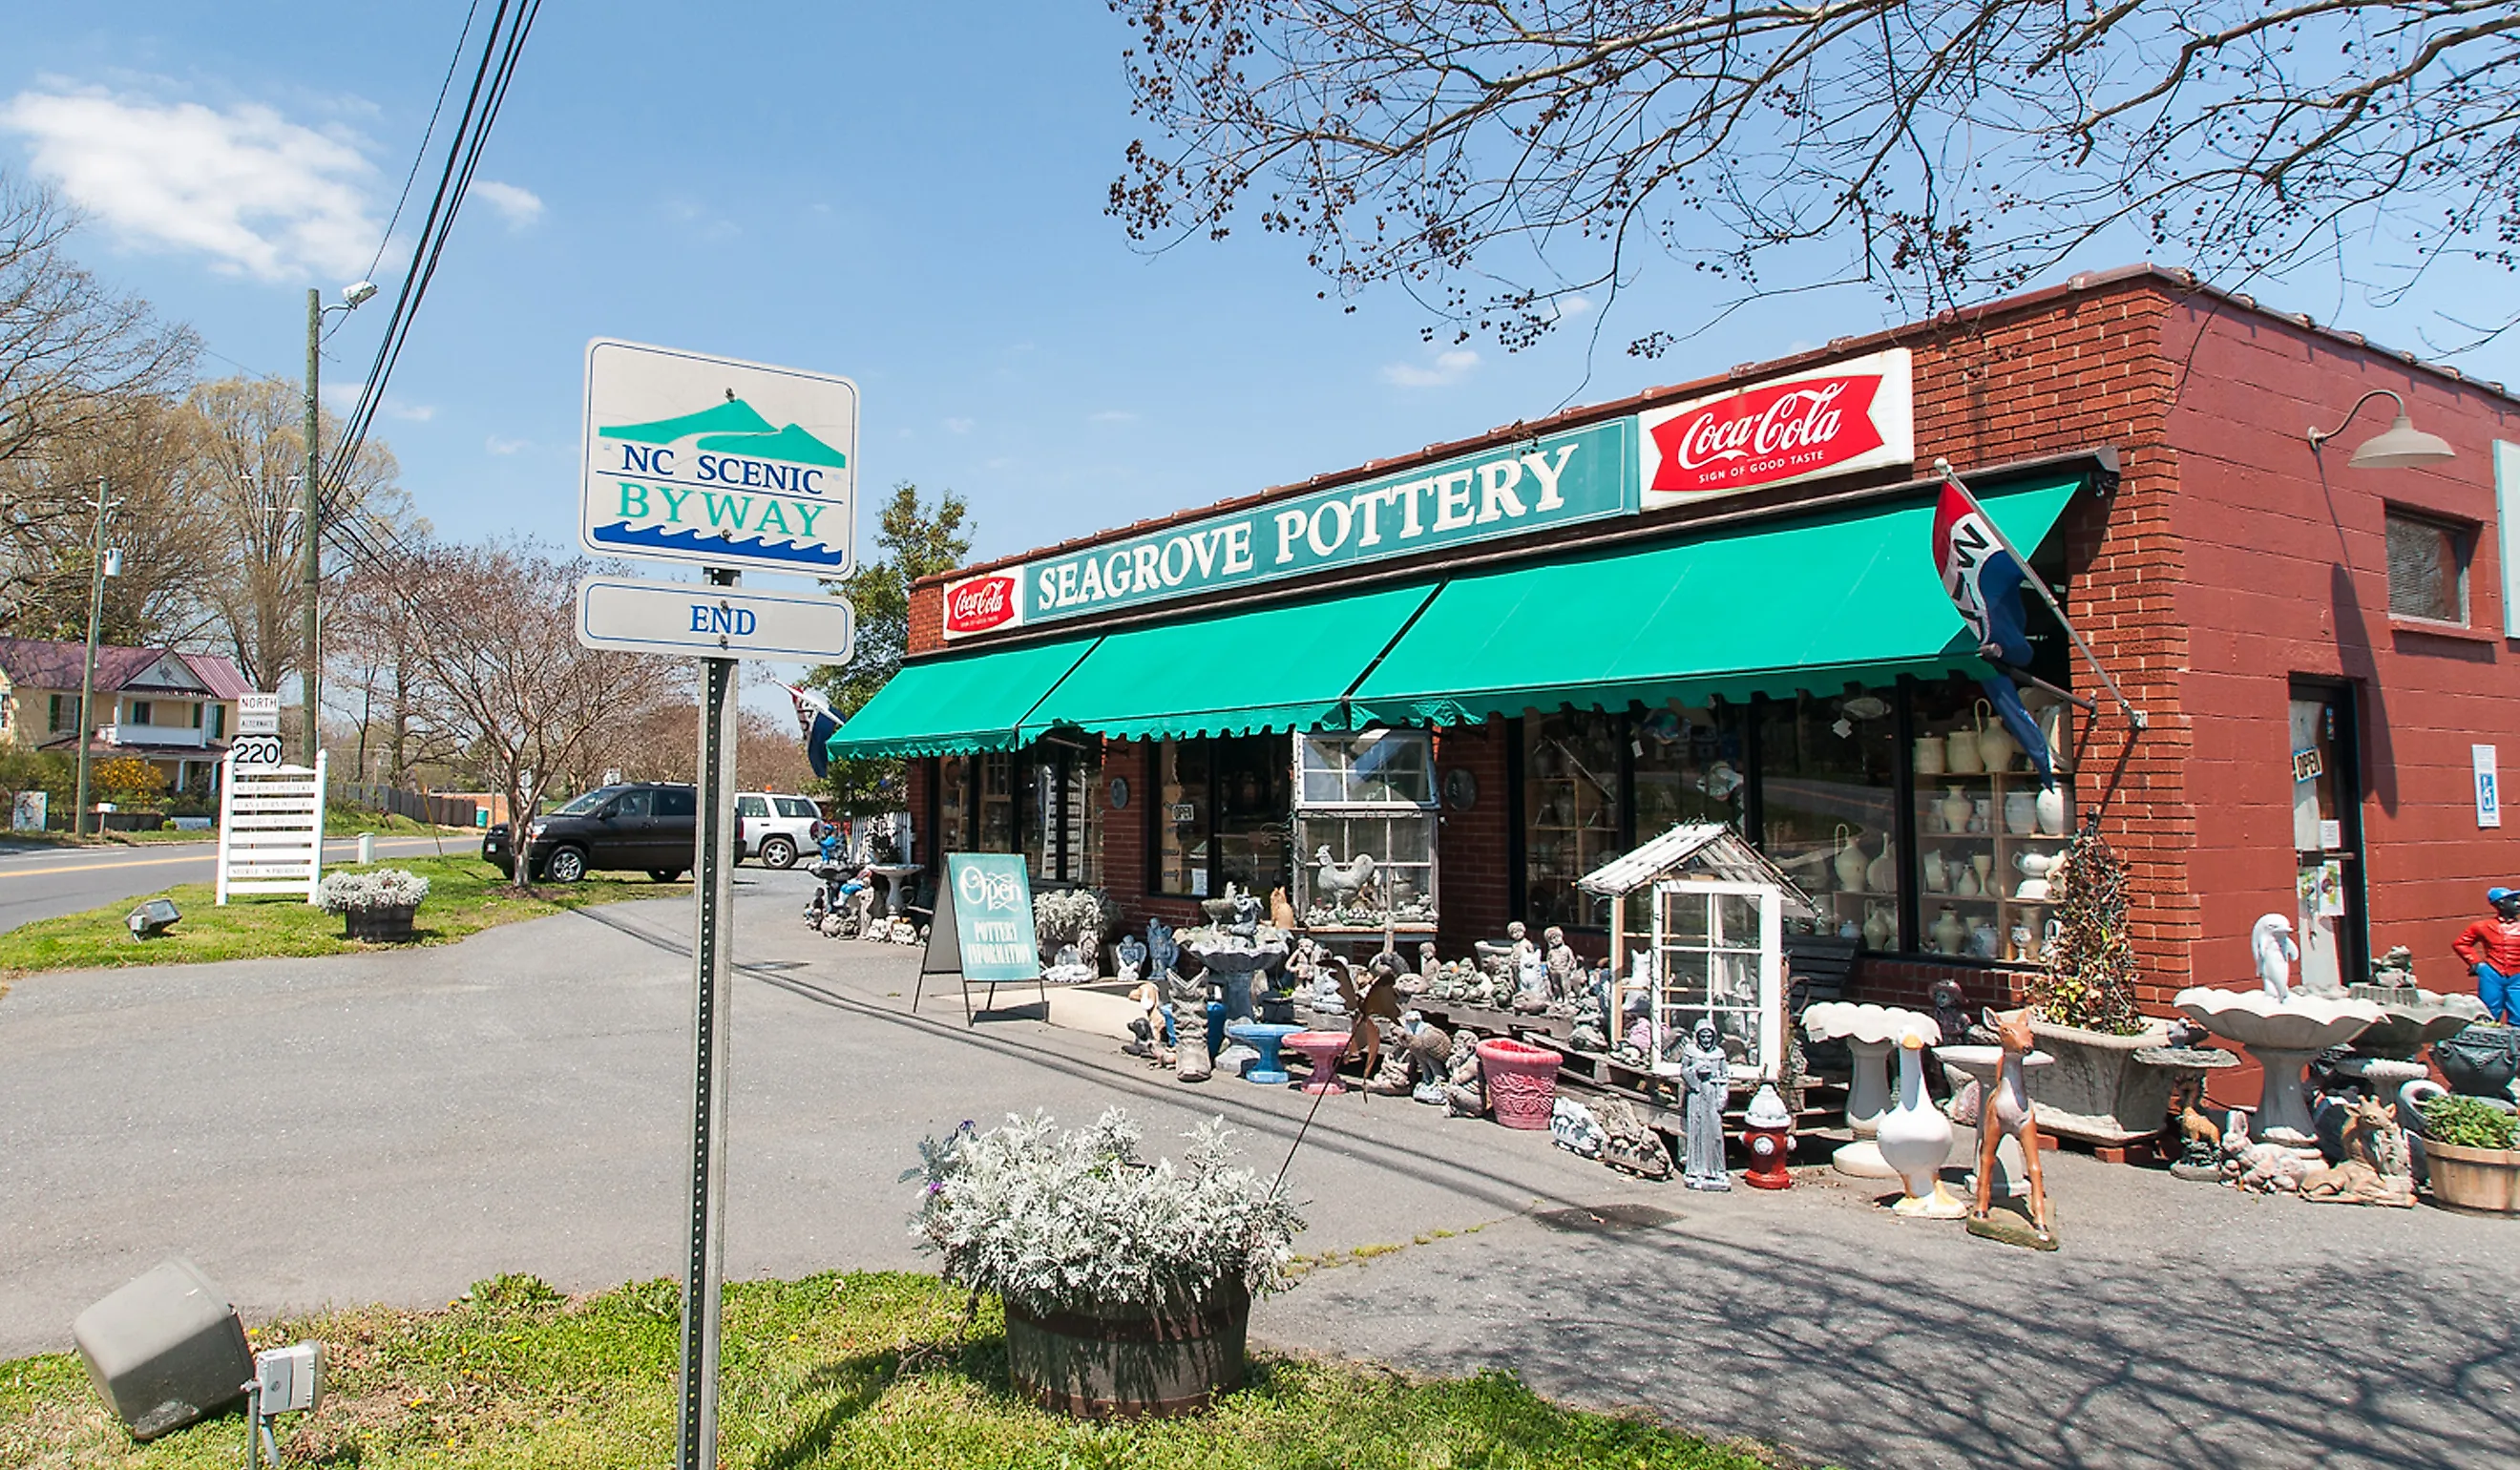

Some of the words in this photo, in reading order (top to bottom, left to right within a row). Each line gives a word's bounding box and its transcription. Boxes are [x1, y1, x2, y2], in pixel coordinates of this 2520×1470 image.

[1678, 381, 1849, 470] Coca-Cola
[621, 444, 675, 474] NC
[697, 454, 824, 494] SCENIC
[1698, 470, 1726, 484] SIGN
[1730, 466, 1746, 477] OF
[1750, 458, 1785, 473] GOOD
[1790, 451, 1825, 465] TASTE
[616, 481, 828, 538] BYWAY
[1038, 521, 1254, 611] SEAGROVE
[1274, 443, 1580, 564] POTTERY
[955, 580, 1005, 620] Coca-Cola
[689, 604, 757, 636] END
[242, 698, 277, 708] NORTH
[235, 743, 279, 764] 220
[2297, 752, 2320, 779] OPEN
[959, 866, 1023, 913] Open
[974, 921, 1018, 942] POTTERY
[967, 943, 1032, 965] INFORMATION
